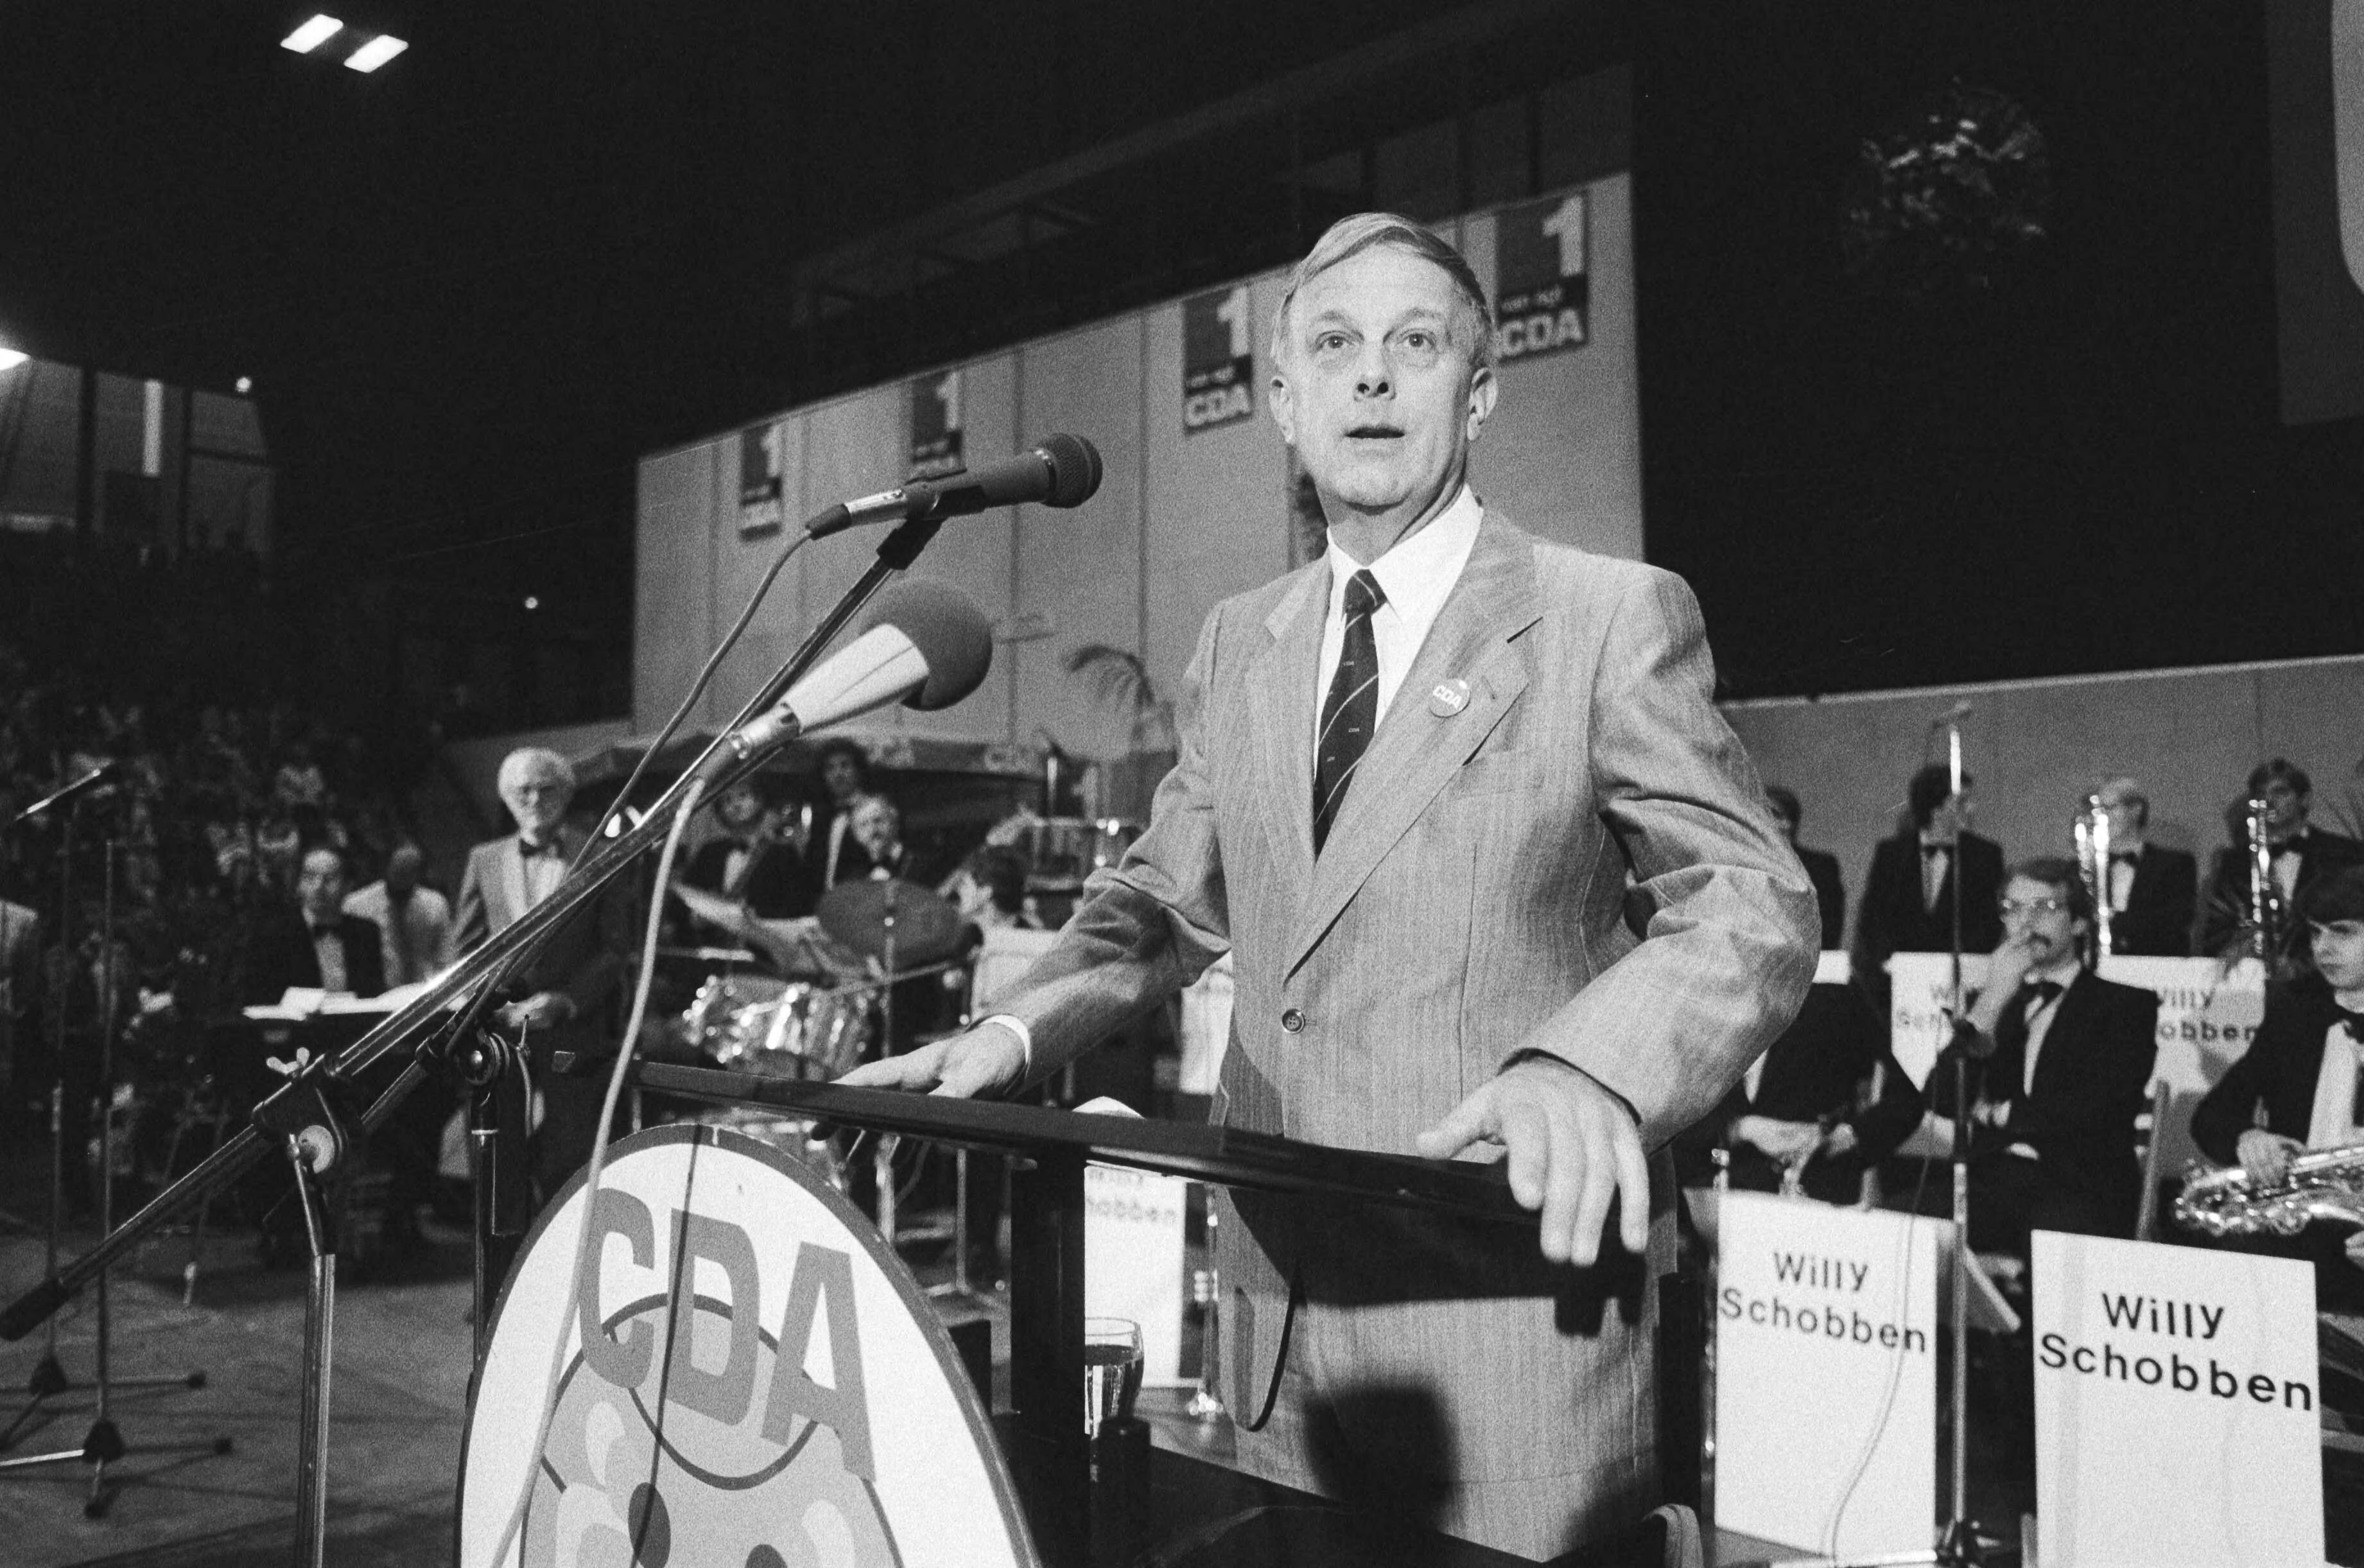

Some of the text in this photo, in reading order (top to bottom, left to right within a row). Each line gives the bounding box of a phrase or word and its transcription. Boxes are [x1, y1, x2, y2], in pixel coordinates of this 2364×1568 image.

[1542, 195, 1585, 277] 1
[1217, 286, 1249, 358] 1
[1497, 308, 1584, 355] CDA
[2160, 1020, 2257, 1042] obben
[1774, 1251, 1868, 1293] Willy
[578, 1187, 876, 1482] CDA
[1719, 1287, 1925, 1353] Schobben
[2101, 1292, 2224, 1339] Willy
[2039, 1332, 2312, 1412] Schobben
